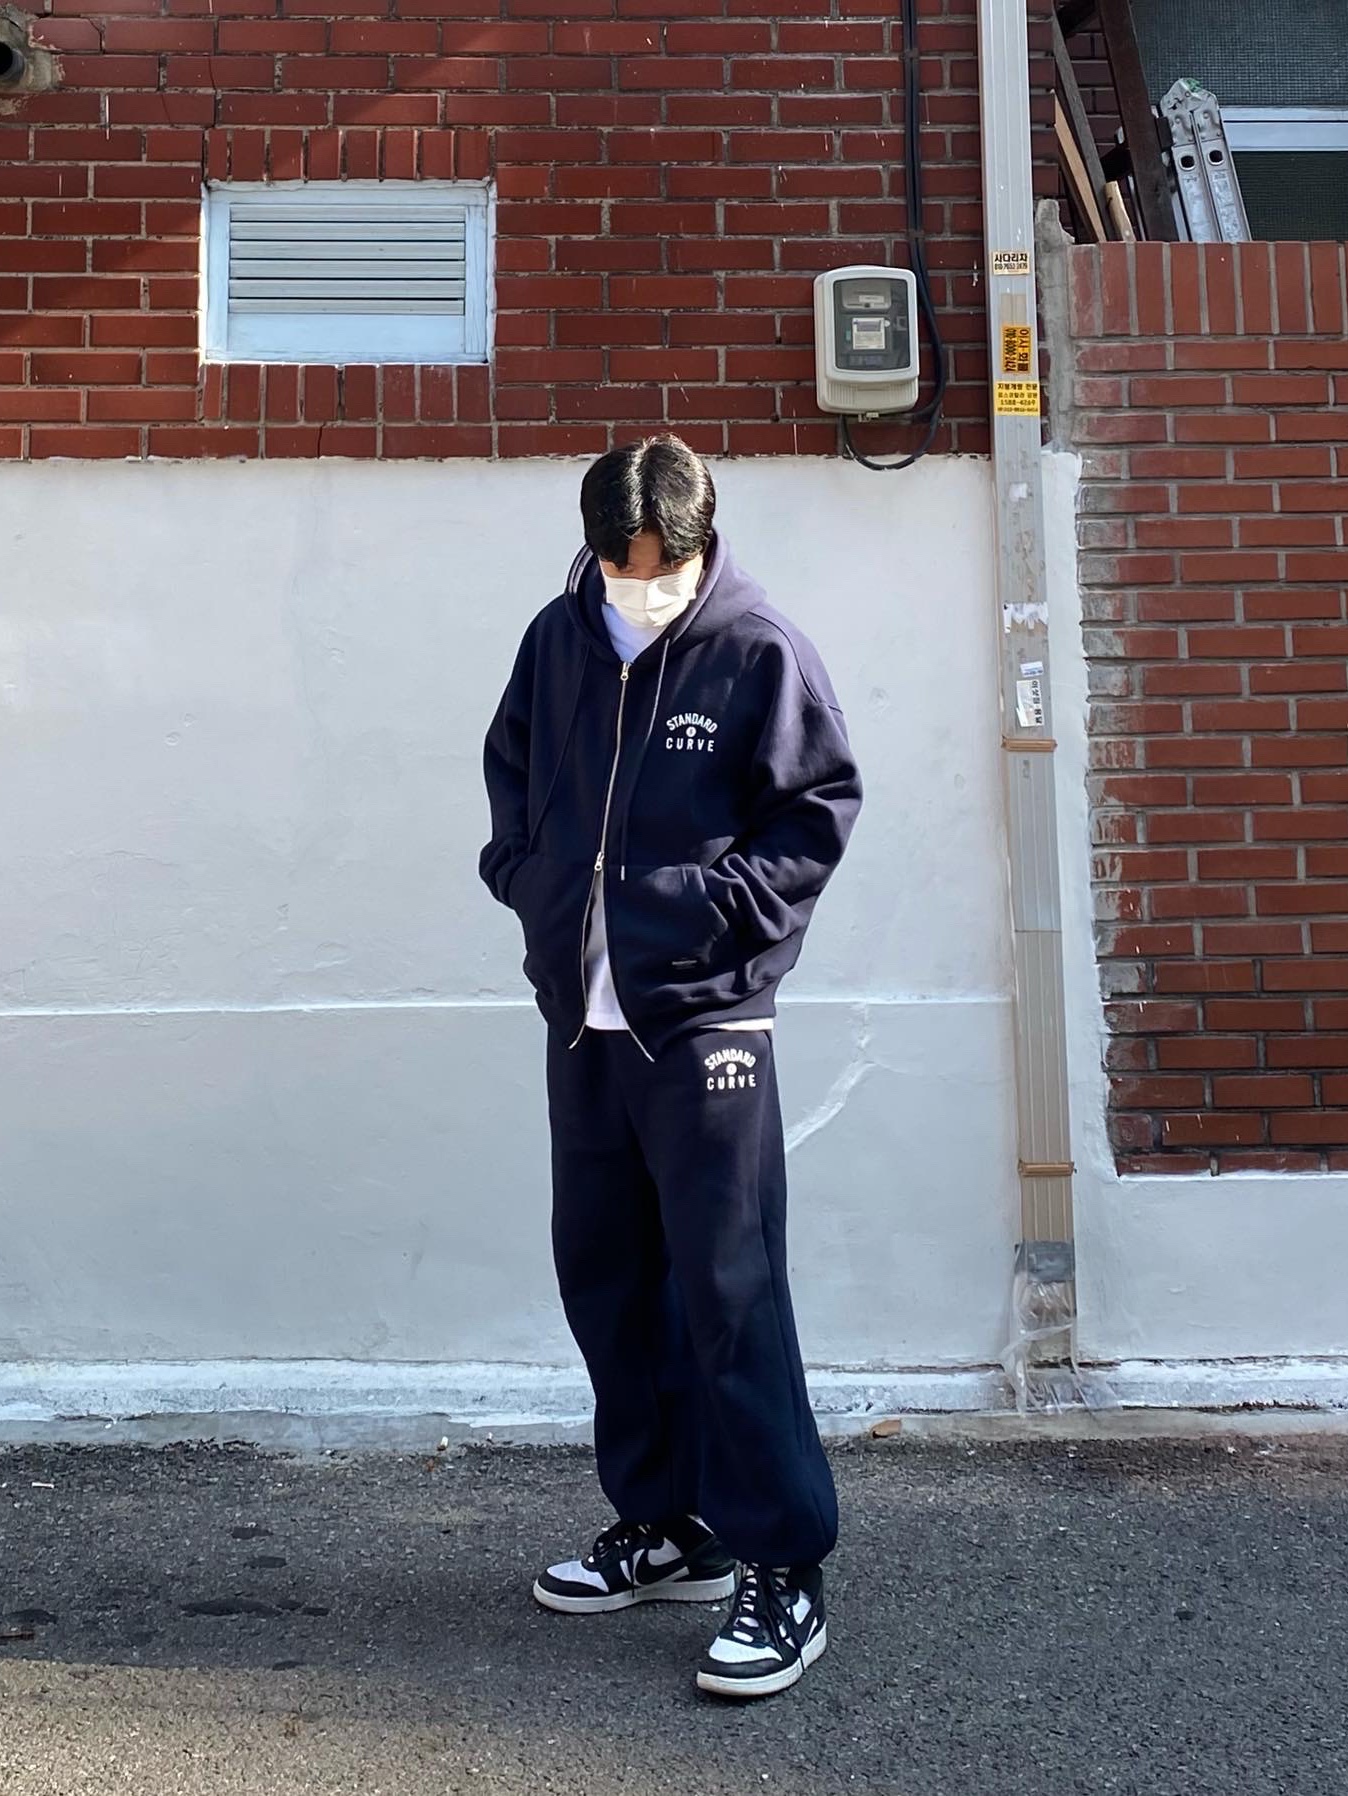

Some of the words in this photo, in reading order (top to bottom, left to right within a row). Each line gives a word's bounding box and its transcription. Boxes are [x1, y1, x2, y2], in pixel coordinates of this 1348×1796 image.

[666, 712, 718, 734] STANDARD
[665, 737, 715, 752] CURVE
[704, 1048, 757, 1071] STANDARD
[707, 1074, 757, 1091] CURVE
